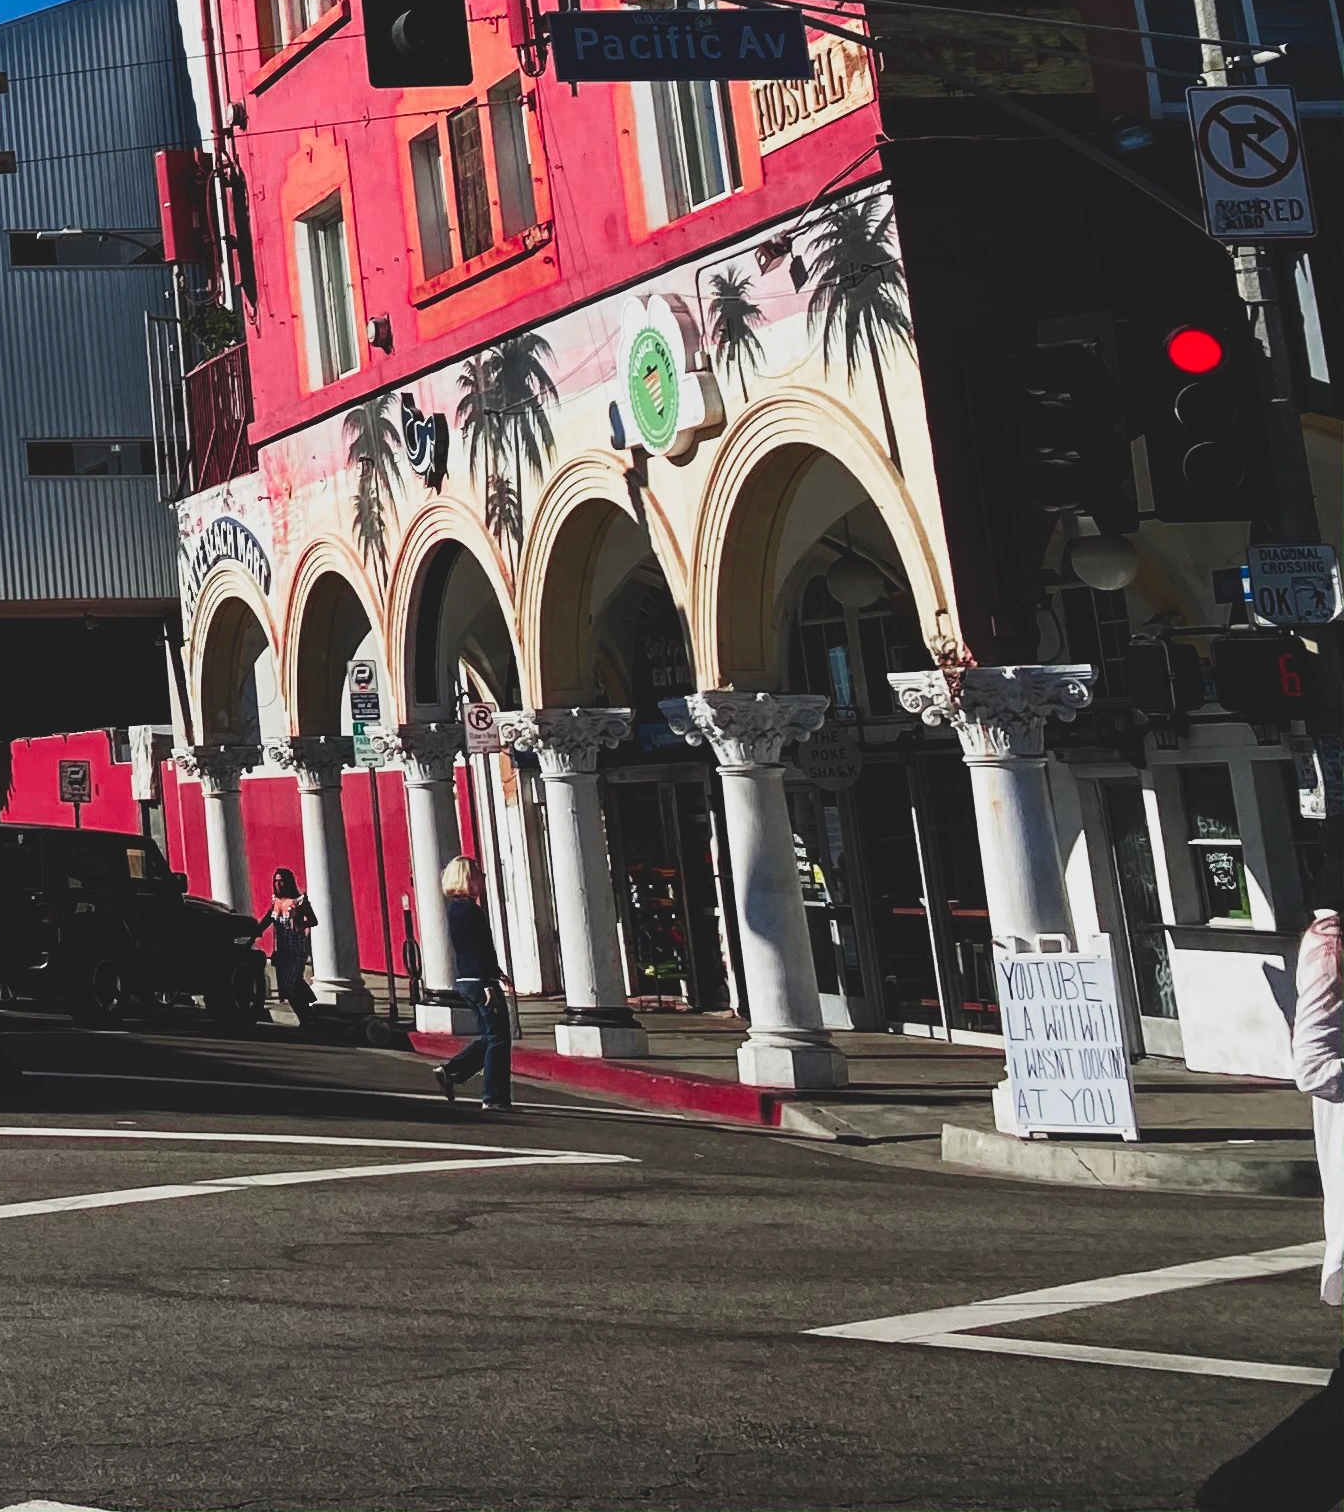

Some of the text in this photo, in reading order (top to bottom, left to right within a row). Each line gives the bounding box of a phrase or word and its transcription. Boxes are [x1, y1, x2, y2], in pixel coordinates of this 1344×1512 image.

[573, 25, 786, 61] Pacific Av
[632, 338, 673, 384] VENICE GRILL
[236, 526, 268, 594] MART
[1258, 548, 1323, 561] DIAGONAL
[1261, 561, 1325, 575] CROSSING
[1259, 587, 1293, 616] OK
[808, 765, 858, 778] SHACK
[999, 961, 1103, 1002] YOUTUBE
[1005, 1006, 1035, 1042] LA
[1018, 1087, 1116, 1126] AT YOU
